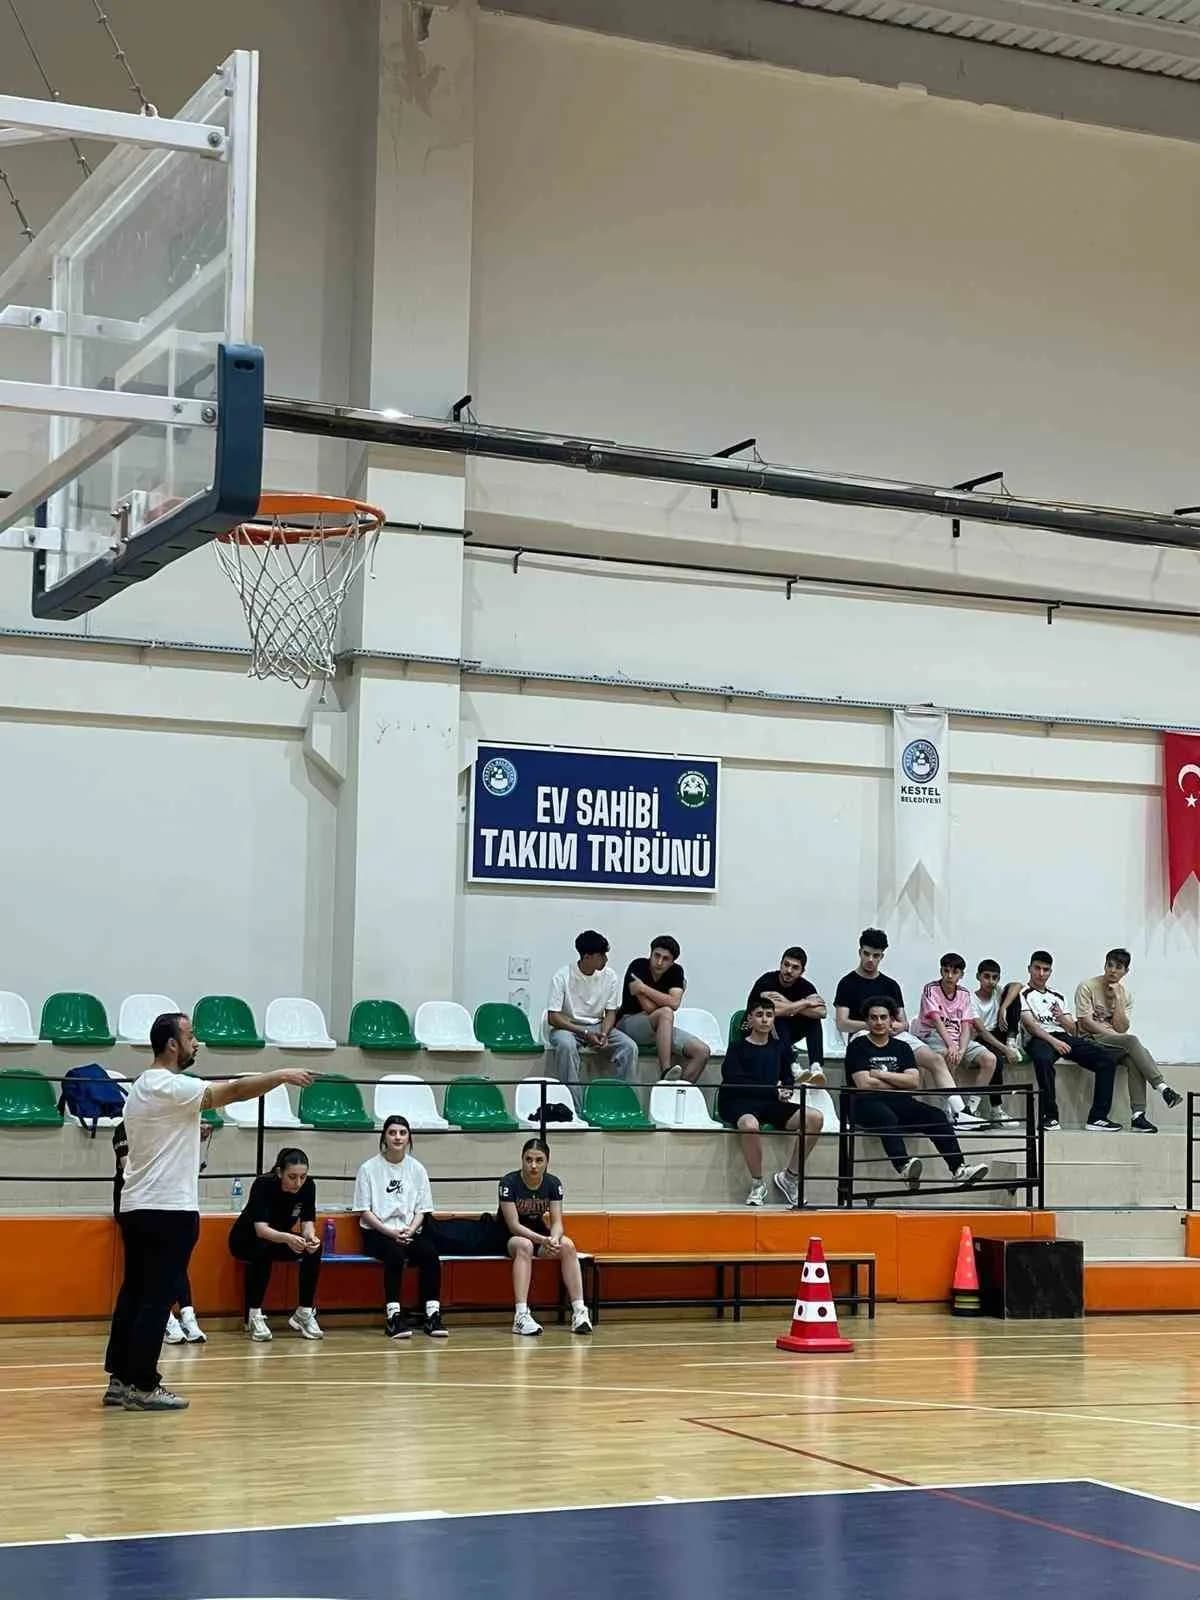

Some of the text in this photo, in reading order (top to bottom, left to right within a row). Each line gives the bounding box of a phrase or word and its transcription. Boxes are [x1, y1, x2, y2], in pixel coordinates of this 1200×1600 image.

[536, 785, 569, 825] EV
[576, 785, 659, 830] SAHİBİ
[901, 785, 940, 796] KESTEL
[480, 828, 711, 877] TAKIM TRİBÜNÜ
